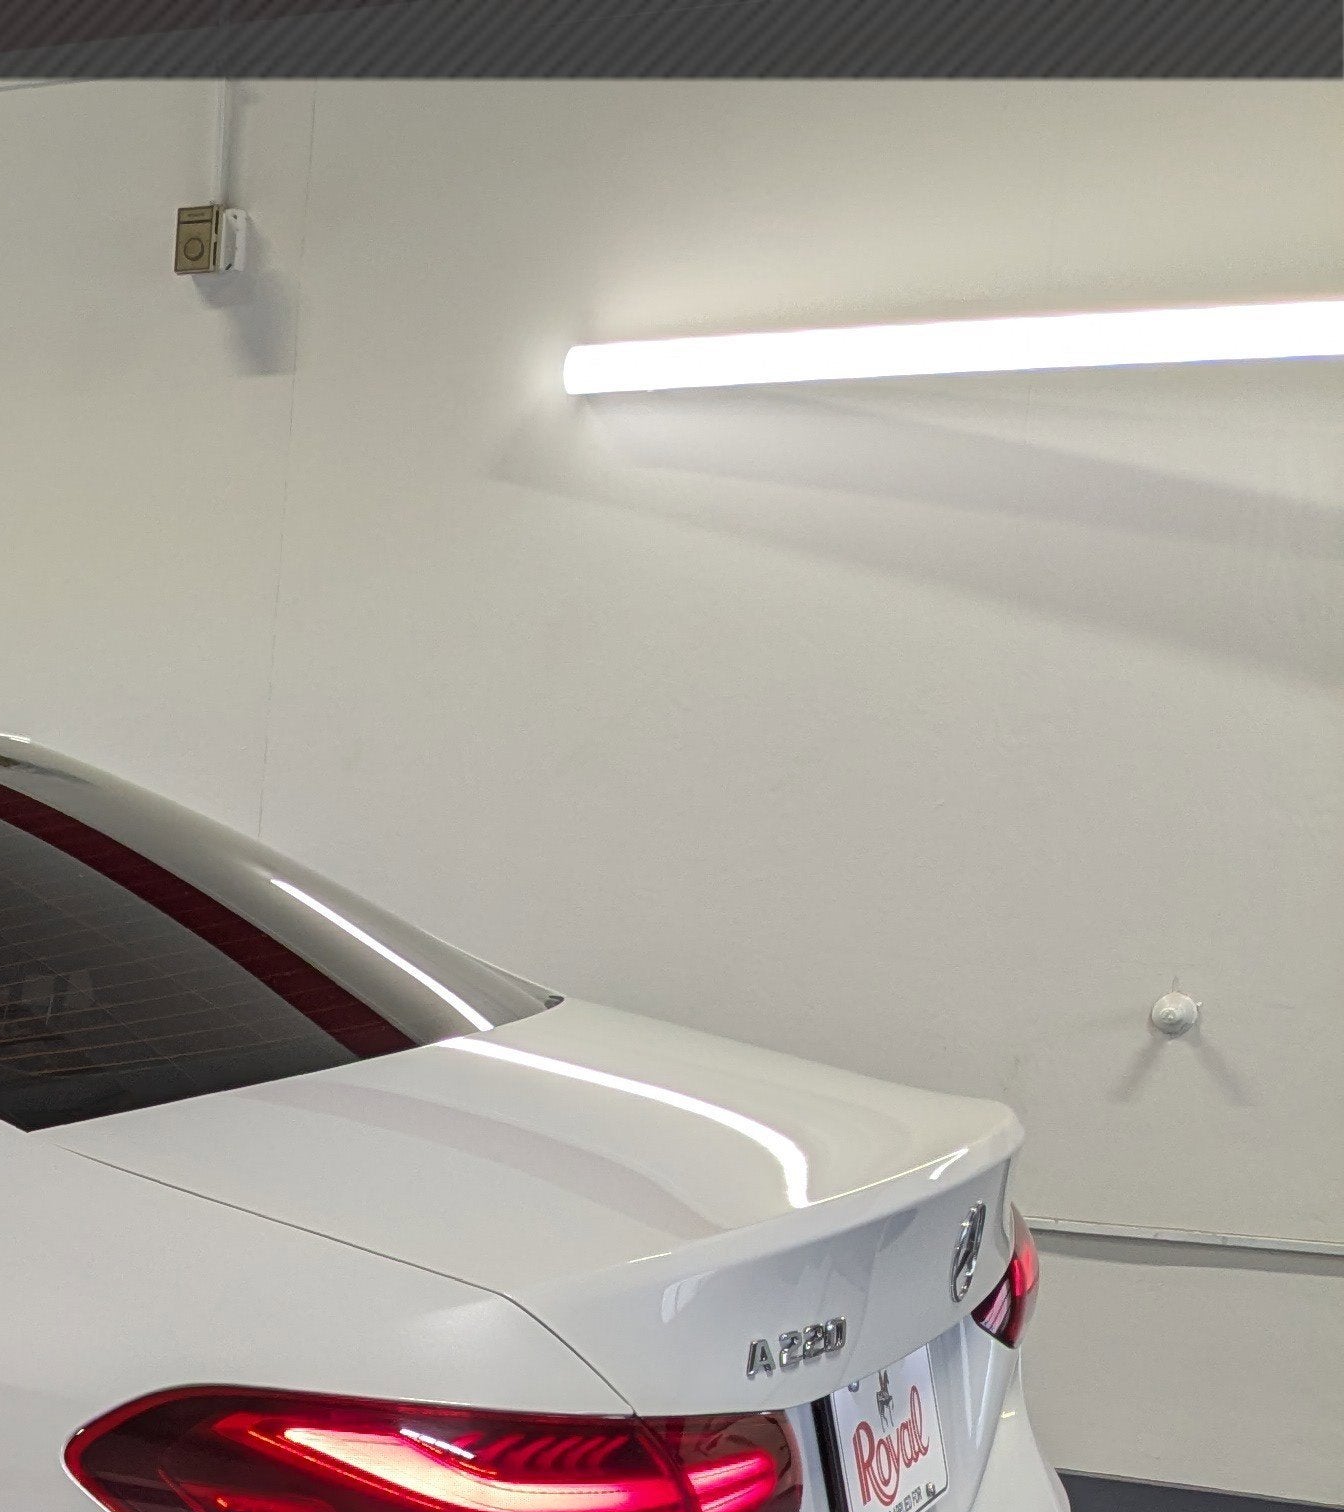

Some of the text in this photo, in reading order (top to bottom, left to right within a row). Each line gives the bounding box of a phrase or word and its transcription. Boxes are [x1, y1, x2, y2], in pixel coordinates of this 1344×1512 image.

[746, 1316, 847, 1377] A 220
[853, 1385, 930, 1507] Royal
